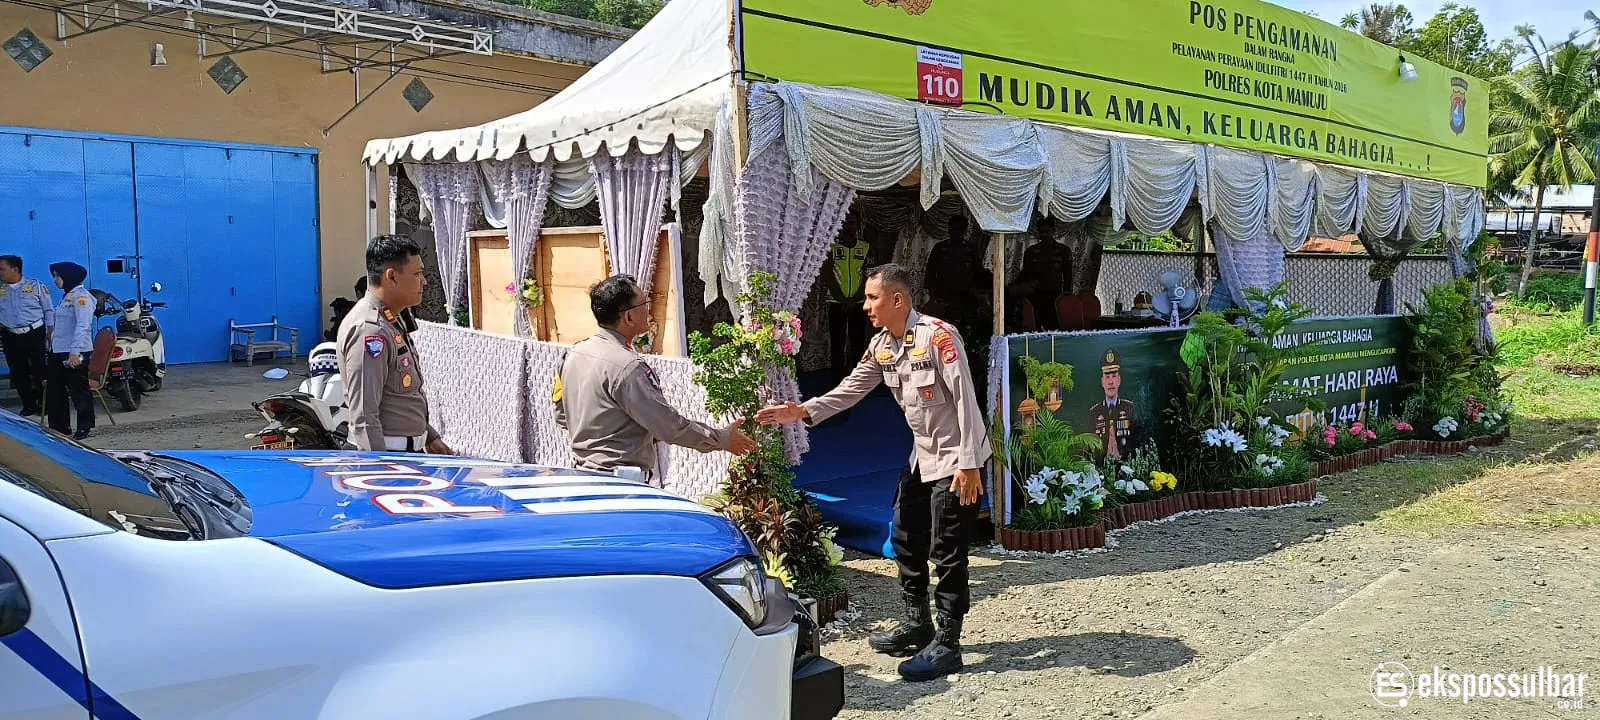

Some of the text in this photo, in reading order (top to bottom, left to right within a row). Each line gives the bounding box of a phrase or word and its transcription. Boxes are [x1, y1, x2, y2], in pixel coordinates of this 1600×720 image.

[1189, 1, 1337, 62] POS PENGAMANAN
[1172, 42, 1216, 62] PELAYANAN
[1218, 52, 1254, 71] PERAYAAN
[1244, 42, 1295, 65] DALAM RANGKA
[922, 74, 959, 98] 110
[1205, 69, 1328, 111] POLRES KOTA MAMUJU
[979, 72, 1093, 117] MUDIK
[1105, 94, 1192, 135] AMAN,
[1203, 110, 1319, 151] KELUARGA
[1342, 328, 1373, 343] BAHAGIA
[1324, 370, 1361, 394] HARI
[1365, 365, 1398, 387] RAYA
